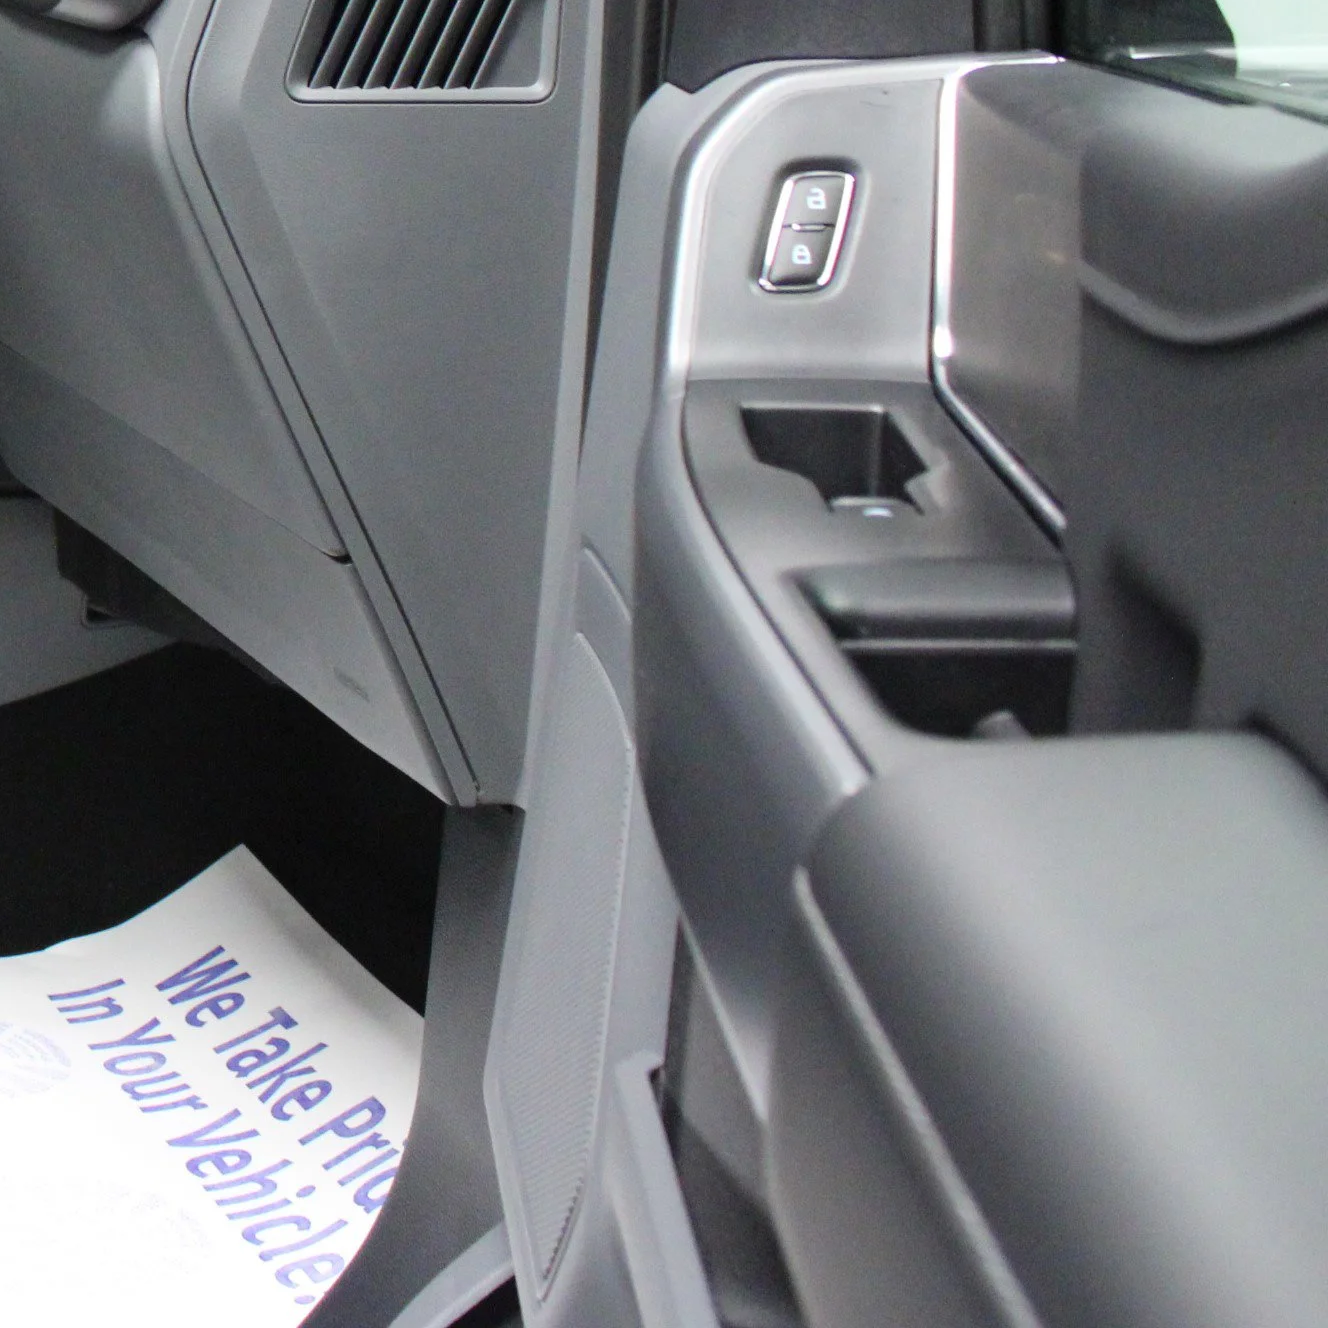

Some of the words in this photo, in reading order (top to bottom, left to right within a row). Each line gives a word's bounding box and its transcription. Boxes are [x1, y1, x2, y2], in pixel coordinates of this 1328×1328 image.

[48, 978, 126, 1025] In
[87, 1016, 209, 1113] Your
[165, 1108, 349, 1306] Vehicle
[155, 945, 252, 1028] We
[213, 1006, 333, 1122] Take
